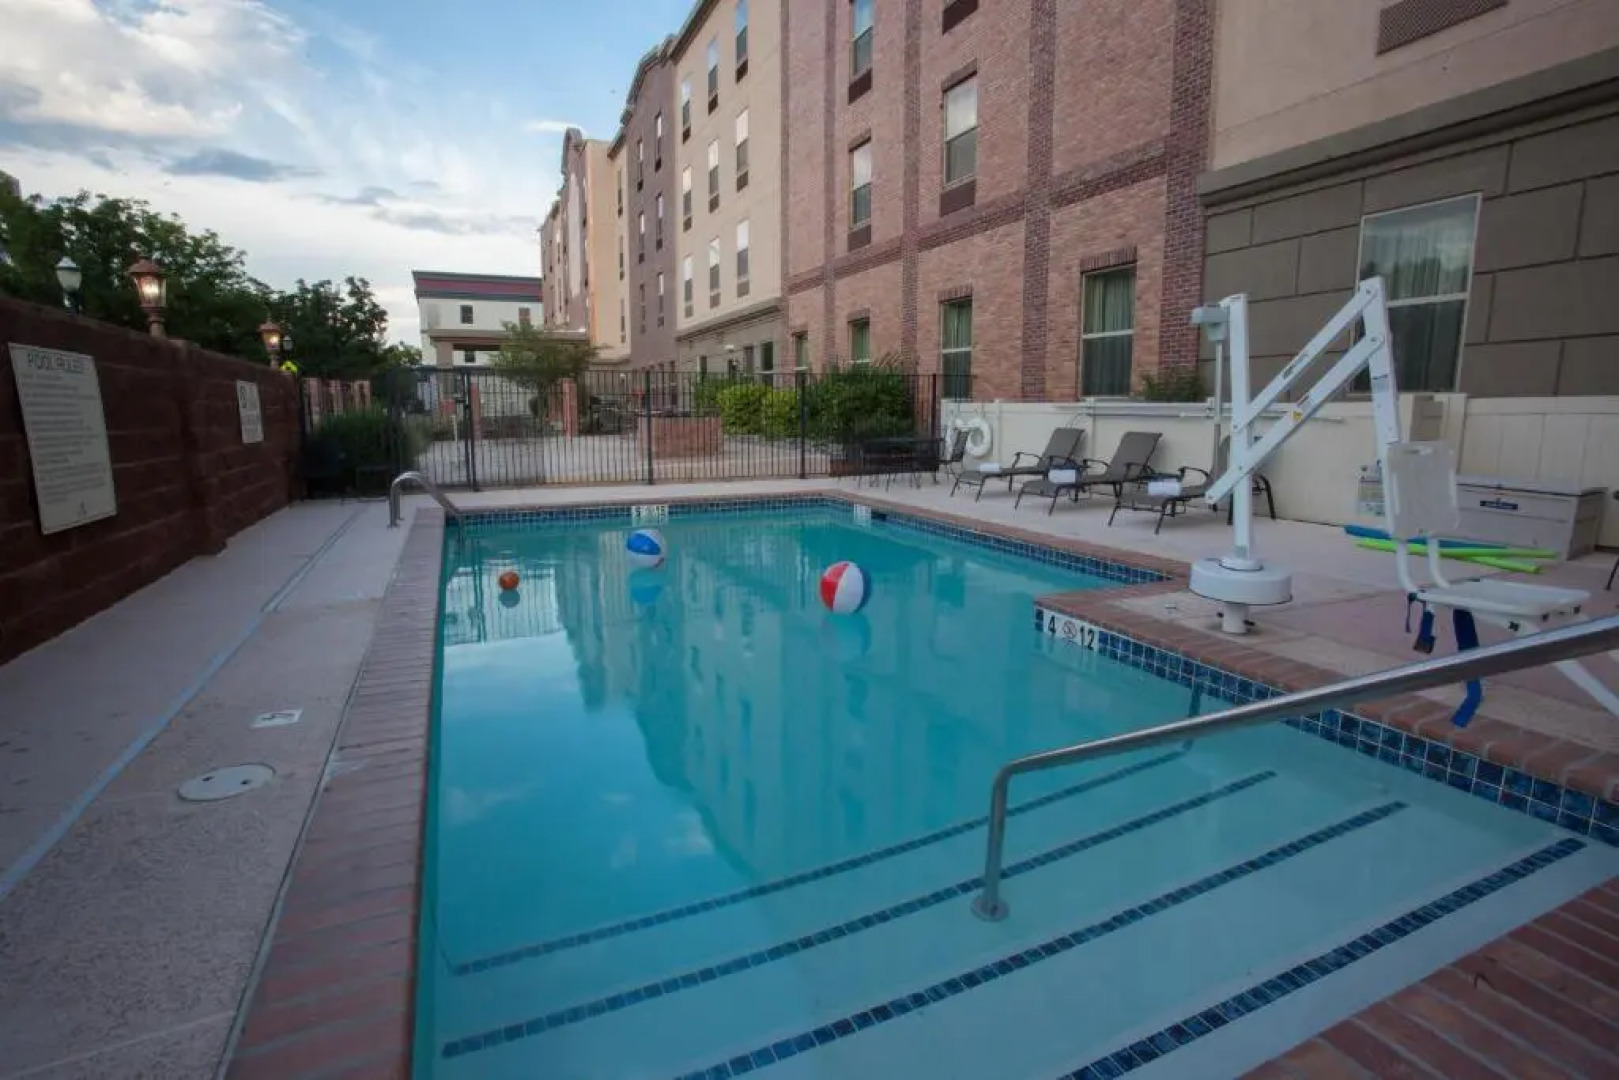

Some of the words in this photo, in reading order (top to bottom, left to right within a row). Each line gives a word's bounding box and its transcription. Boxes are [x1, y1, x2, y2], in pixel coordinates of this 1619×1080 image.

[26, 351, 54, 371] POOL
[1048, 614, 1057, 634] 4
[1080, 625, 1095, 651] 12
